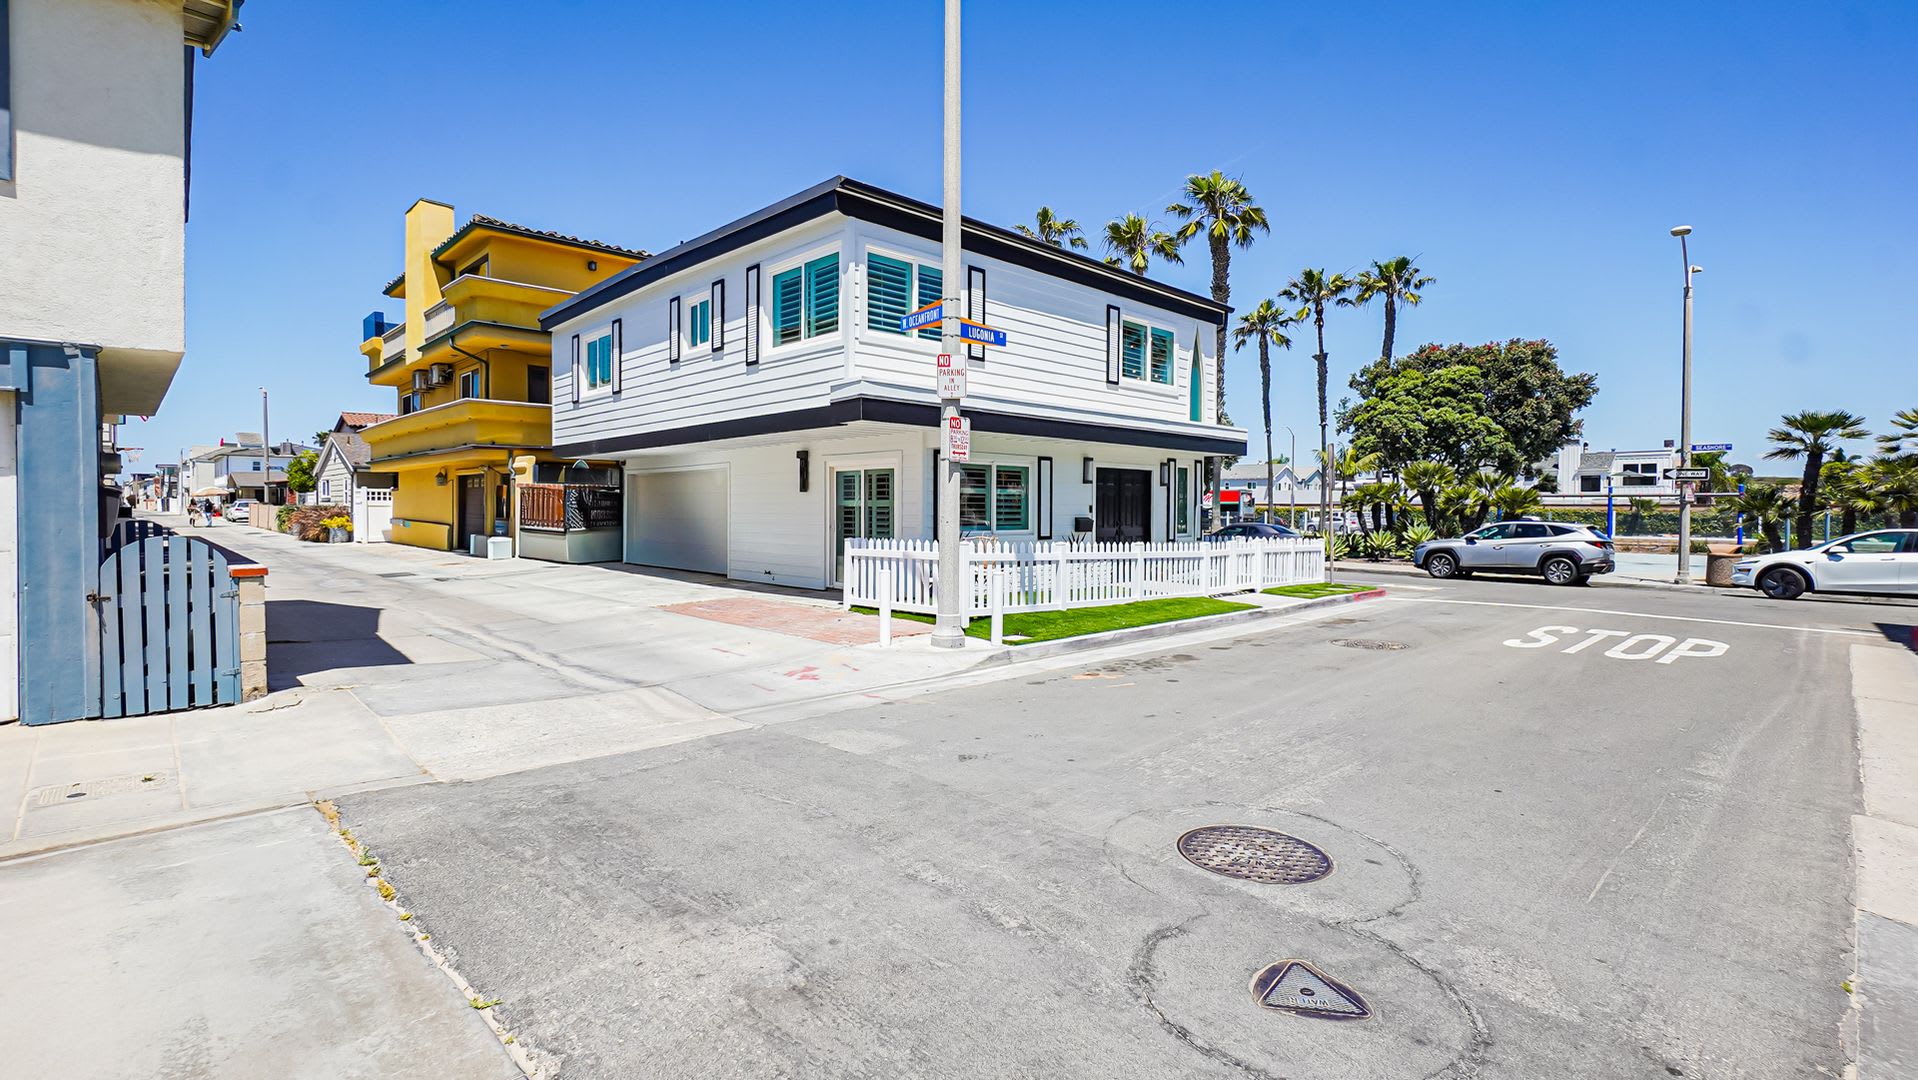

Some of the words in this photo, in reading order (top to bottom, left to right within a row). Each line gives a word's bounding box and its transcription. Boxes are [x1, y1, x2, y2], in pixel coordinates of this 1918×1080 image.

[902, 318, 909, 330] W.
[909, 308, 940, 328] OCEANFRONT
[968, 326, 995, 343] LUGONIA
[938, 355, 950, 366] NO
[940, 368, 965, 377] PARKING
[950, 418, 961, 429] NO
[1502, 625, 1730, 664] STOP
